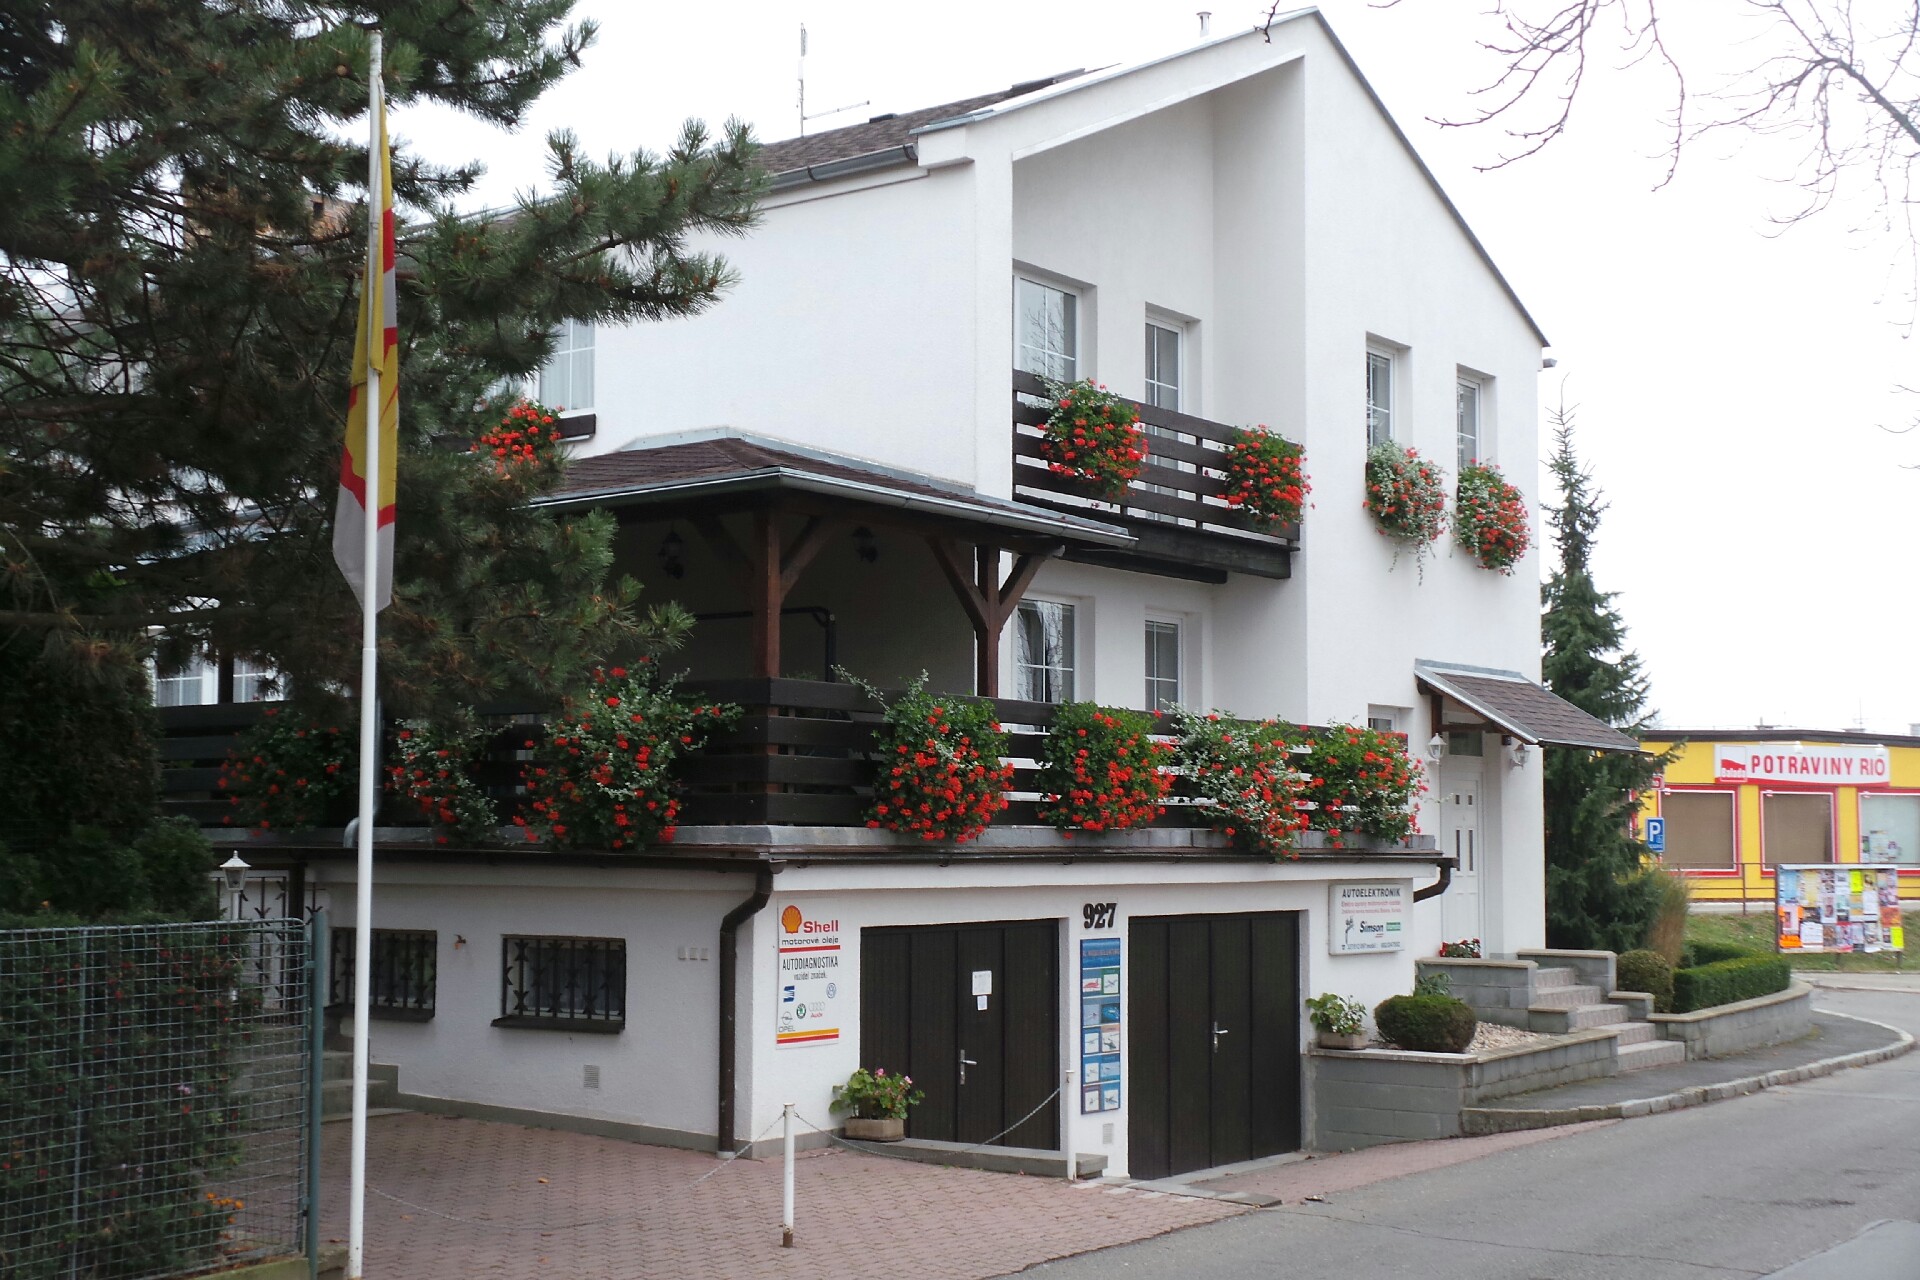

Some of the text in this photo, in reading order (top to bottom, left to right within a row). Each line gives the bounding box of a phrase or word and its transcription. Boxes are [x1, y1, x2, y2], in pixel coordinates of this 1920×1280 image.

[1751, 755, 1885, 776] POTRAVINY RIO
[1649, 821, 1661, 842] P
[1342, 888, 1401, 898] AUTOELEKTRONIK
[1083, 903, 1117, 929] 927
[803, 920, 839, 933] Shell
[1360, 920, 1384, 933] Simson
[782, 935, 839, 946] motorové oleje
[782, 956, 839, 970] AUTODIAGNOSTIKA
[778, 1025, 796, 1033] OPEL
